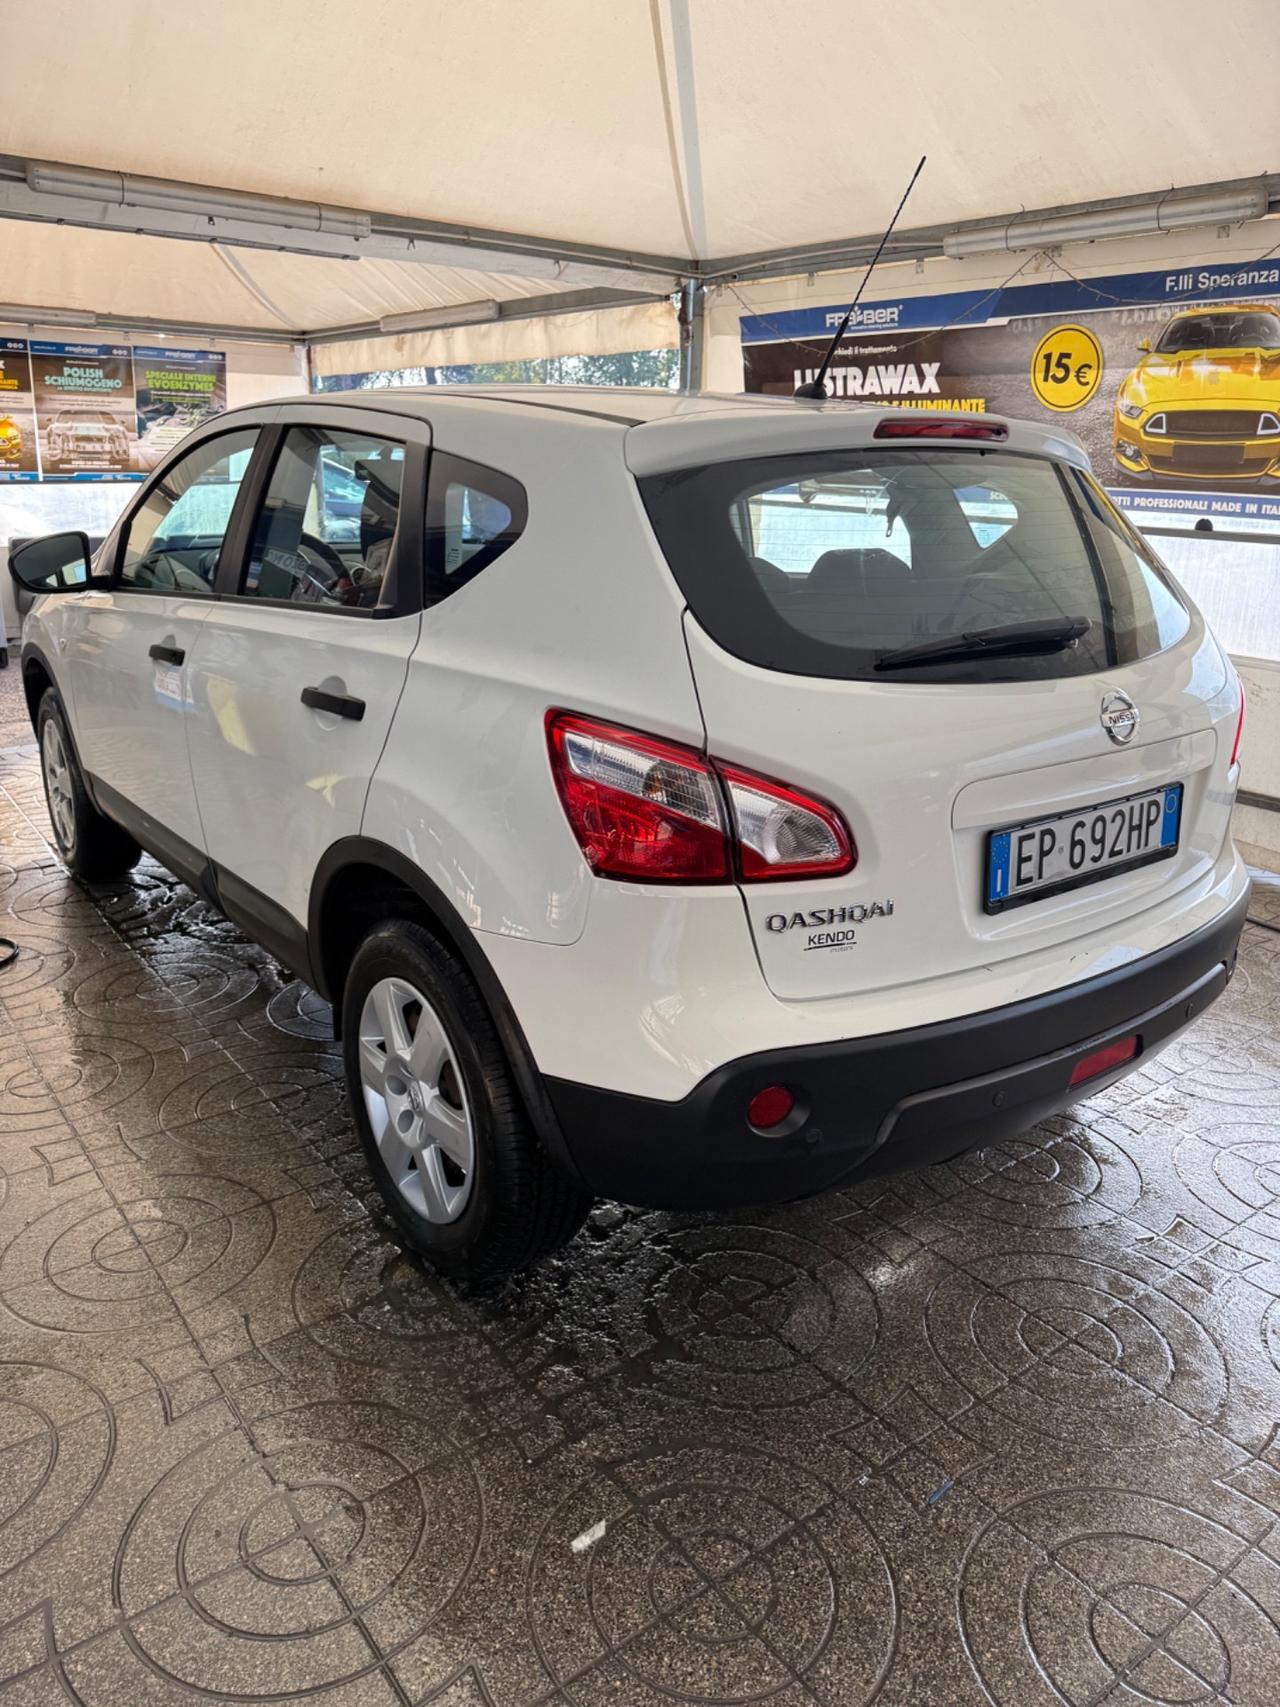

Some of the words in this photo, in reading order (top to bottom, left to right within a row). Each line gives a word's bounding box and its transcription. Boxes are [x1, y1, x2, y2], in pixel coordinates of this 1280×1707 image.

[1198, 269, 1279, 293] Speranza
[859, 344, 897, 354] trattamento
[63, 367, 104, 379] POLISH
[145, 370, 183, 380] SPECIALE
[44, 375, 122, 389] SCHIUMOGENO
[148, 380, 215, 392] EVOENZYMES
[1134, 497, 1208, 510] PROFESSIONALI
[1211, 502, 1241, 513] MADE
[1245, 503, 1257, 514] IN
[1261, 503, 1280, 515] ITA
[1016, 829, 1057, 887] EP
[1069, 799, 1161, 870] 692HP
[808, 930, 855, 945] KENDO
